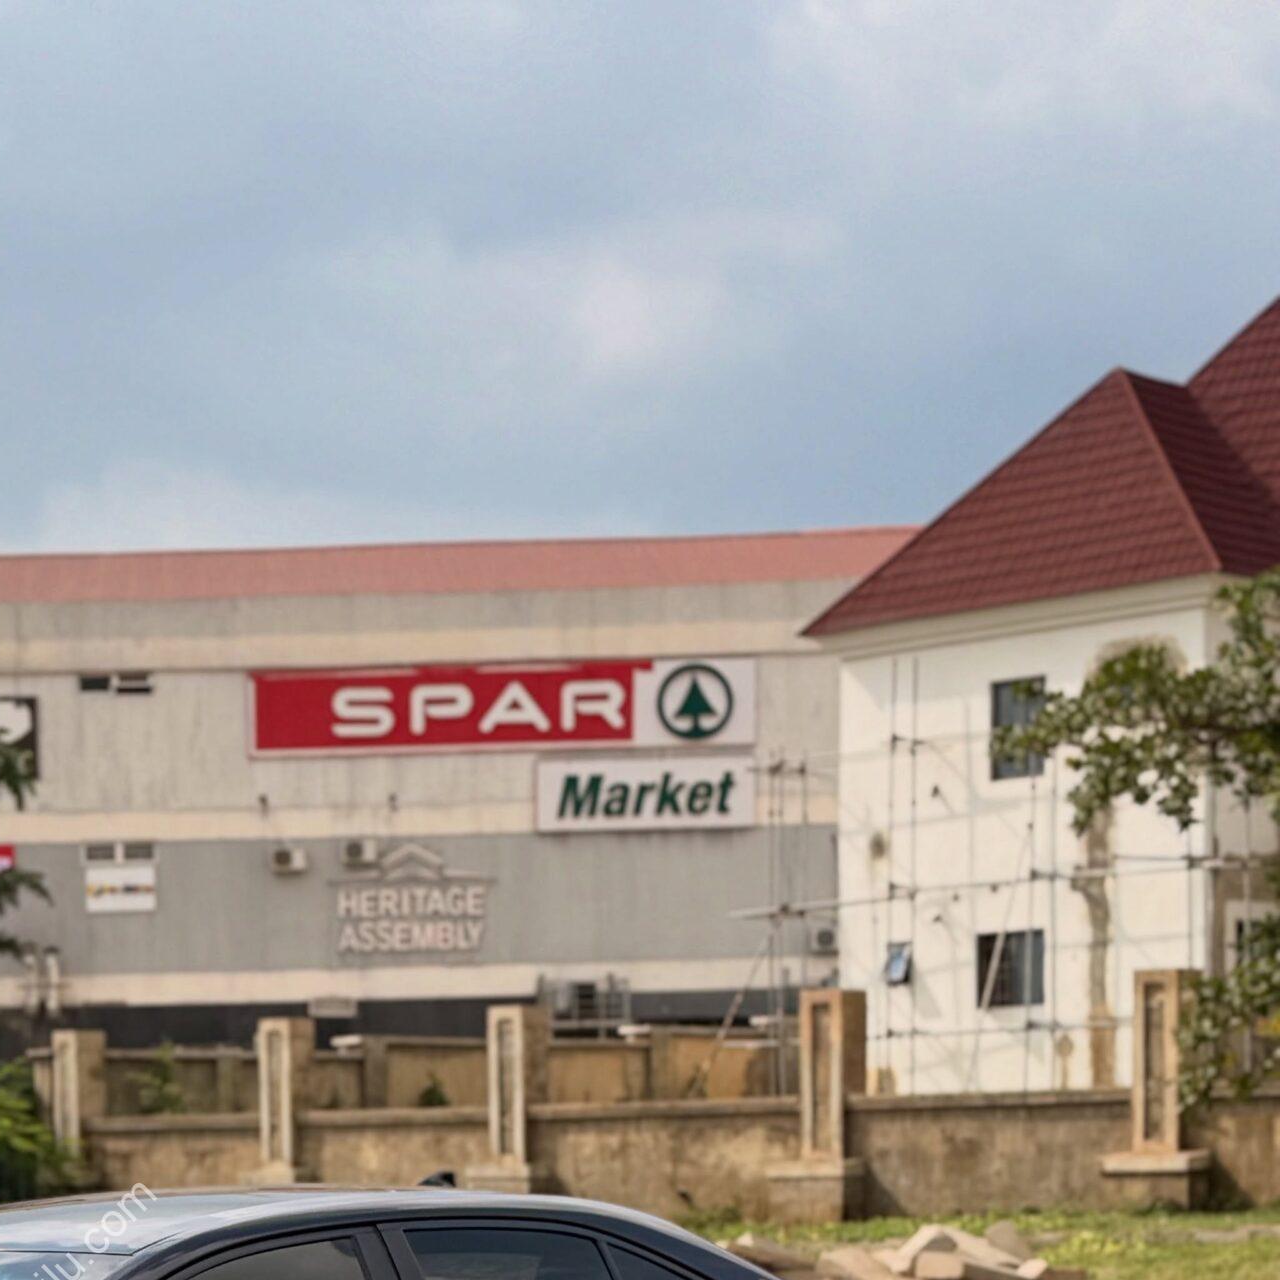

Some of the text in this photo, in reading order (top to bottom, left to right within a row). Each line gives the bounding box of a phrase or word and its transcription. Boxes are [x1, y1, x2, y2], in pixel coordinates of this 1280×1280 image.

[330, 679, 627, 738] SPAR
[557, 771, 736, 820] Market
[336, 885, 486, 917] HERITAGE
[337, 921, 484, 951] ASSEMBLY
